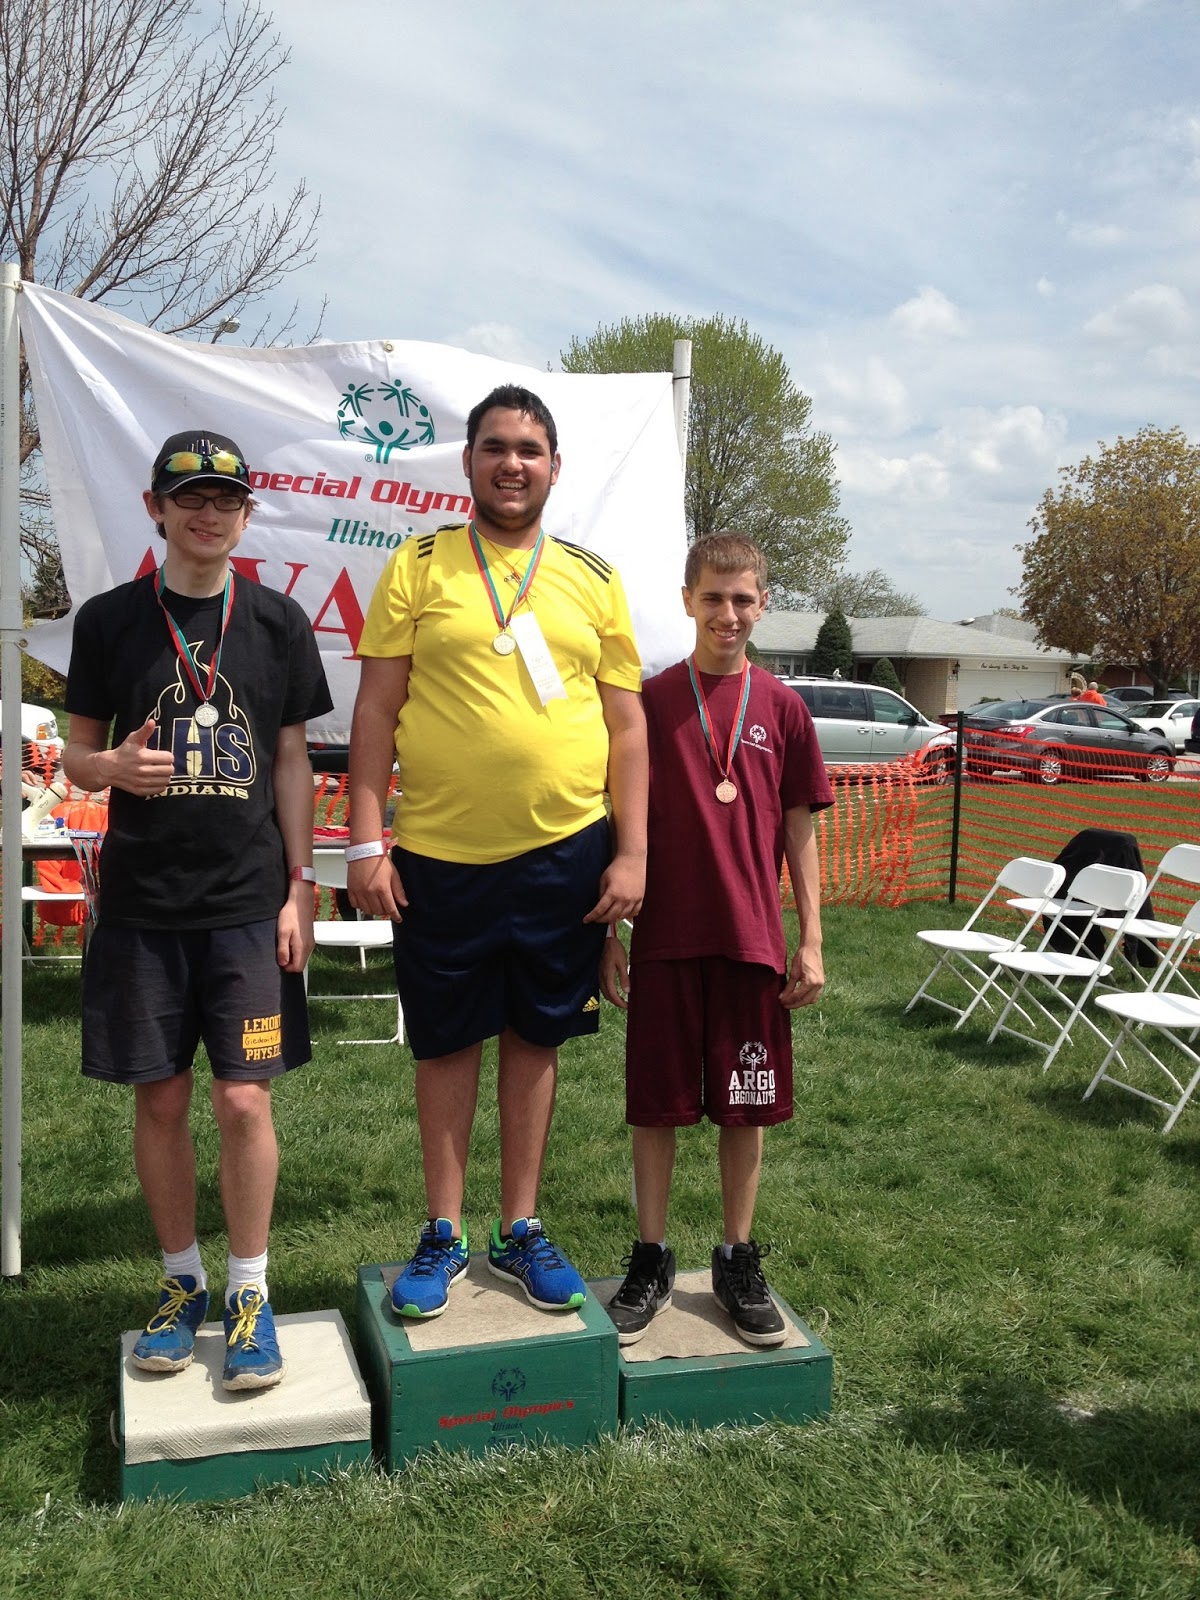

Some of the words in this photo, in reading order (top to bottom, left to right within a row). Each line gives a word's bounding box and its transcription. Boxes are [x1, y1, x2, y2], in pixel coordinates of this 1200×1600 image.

[248, 466, 361, 500] pecial
[370, 477, 476, 520] Olym
[145, 784, 249, 800] DIANS
[728, 1068, 776, 1091] ARGO
[439, 1408, 497, 1429] Special
[503, 1400, 574, 1418] Olympics
